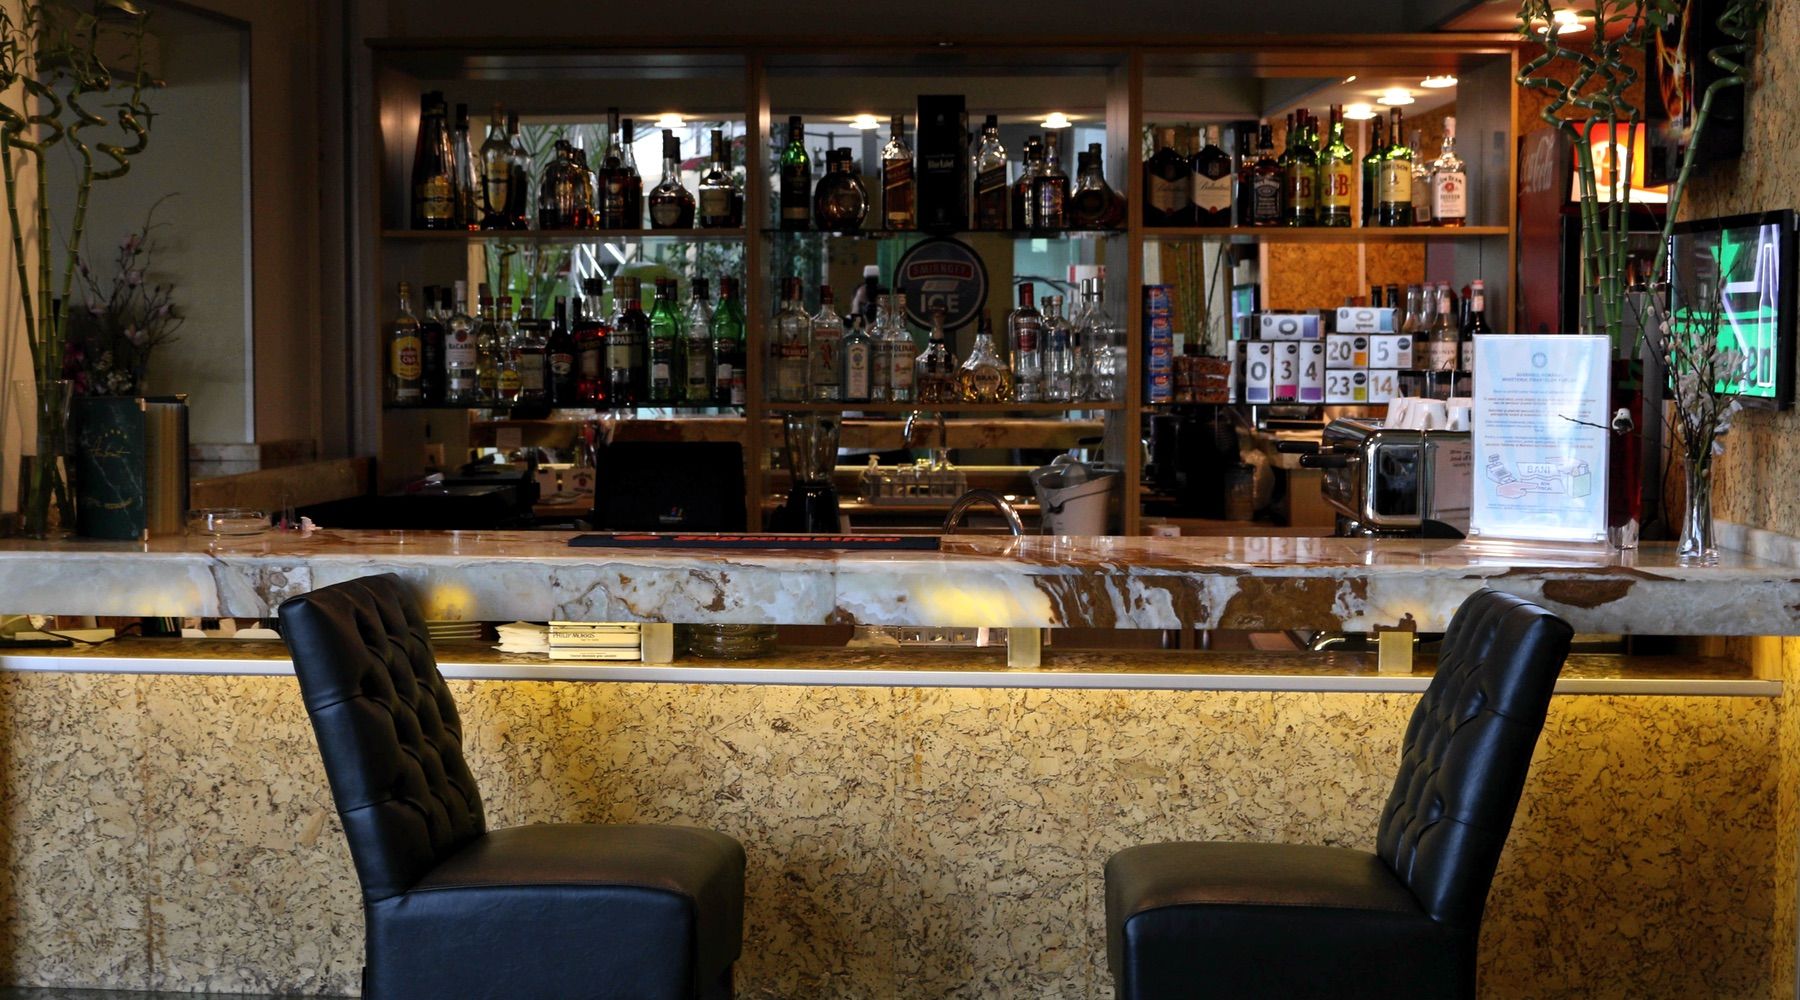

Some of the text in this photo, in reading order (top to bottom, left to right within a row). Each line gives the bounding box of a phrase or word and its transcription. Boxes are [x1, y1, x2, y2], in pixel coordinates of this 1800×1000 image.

[912, 263, 967, 275] SMIRNOFF
[920, 294, 960, 313] ICE
[1328, 341, 1352, 361] 20
[1377, 341, 1389, 361] 5
[1251, 361, 1267, 381] 0
[1281, 360, 1292, 380] 3
[1304, 361, 1317, 381] 4
[1328, 376, 1350, 395] 23
[1371, 376, 1392, 395] 14
[1527, 465, 1550, 474] BANI
